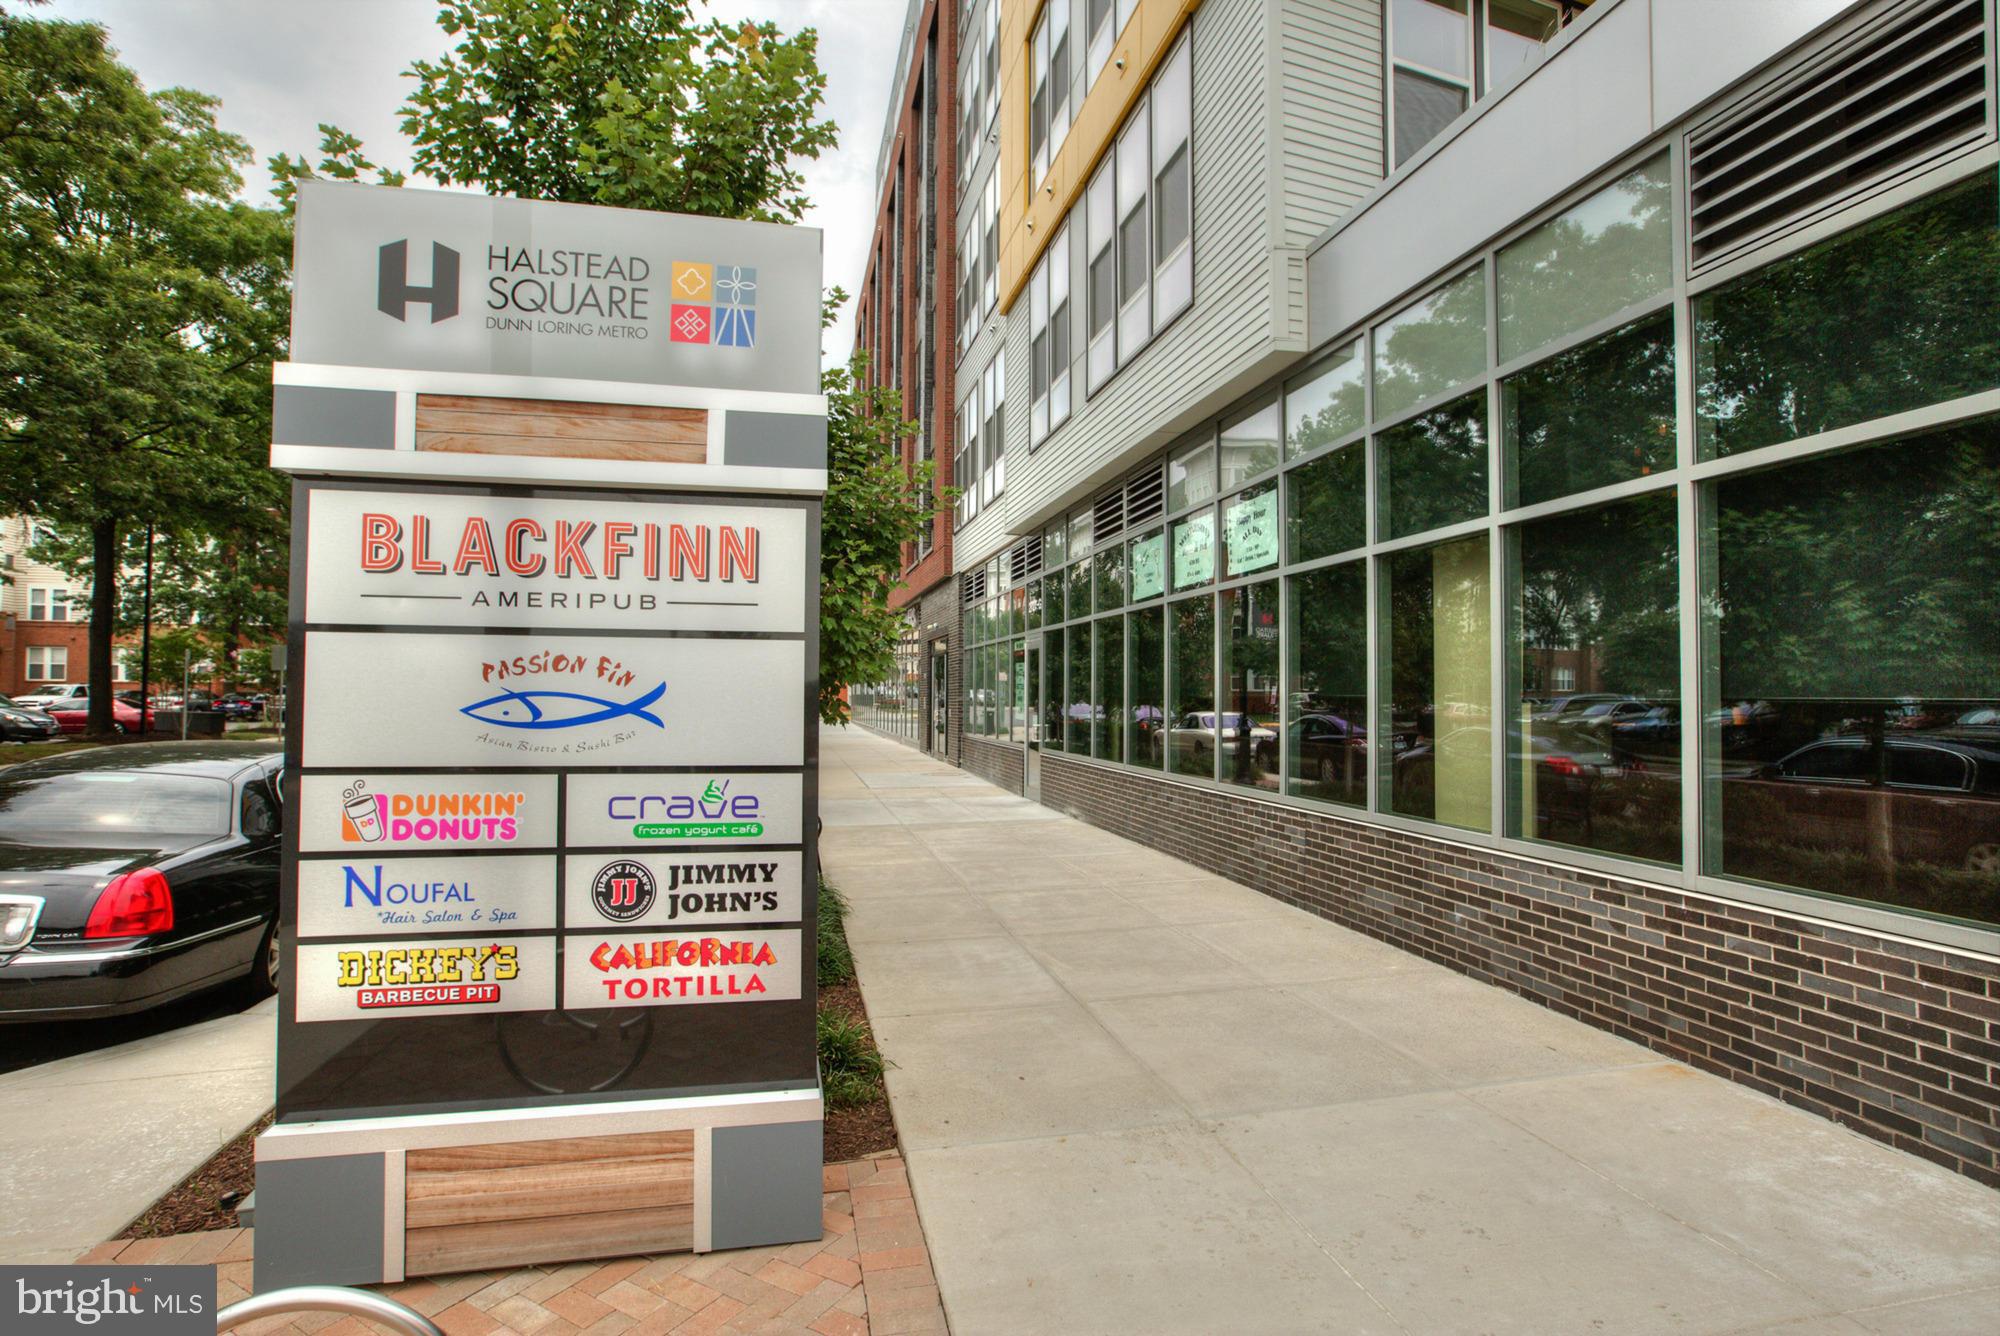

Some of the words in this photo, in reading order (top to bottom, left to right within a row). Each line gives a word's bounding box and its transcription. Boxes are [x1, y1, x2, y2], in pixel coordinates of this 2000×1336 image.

[488, 245, 650, 282] HALSTEAD
[487, 276, 649, 321] SQUARE
[486, 316, 533, 331] DUNN
[537, 320, 593, 336] LORING
[598, 325, 649, 340] METRO
[361, 513, 760, 584] BLACKFINN
[471, 591, 657, 610] AMERIPUB
[475, 732, 513, 749] Asian
[516, 740, 557, 752] Bistro
[561, 744, 571, 753] &
[576, 739, 610, 753] Sushi
[612, 730, 637, 745] Bar
[391, 794, 525, 817] DUNKIN'
[608, 796, 760, 819] crave
[391, 818, 518, 842] DONUTS
[638, 826, 681, 835] frozen
[685, 825, 728, 837] yogurt
[731, 824, 759, 834] café
[597, 865, 622, 892] JIMMY
[624, 865, 652, 891] JOHN'S
[668, 863, 778, 891] JIMMY
[611, 878, 639, 907] JJ
[422, 910, 464, 924] Salon
[470, 909, 483, 921] &
[489, 908, 518, 924] Spa
[668, 891, 778, 920] JOHN'S
[589, 938, 778, 973] CALIFORNIA
[361, 987, 461, 1005] BARBECUE
[466, 986, 495, 1000] PIT
[602, 973, 767, 1001] TORTILLA
